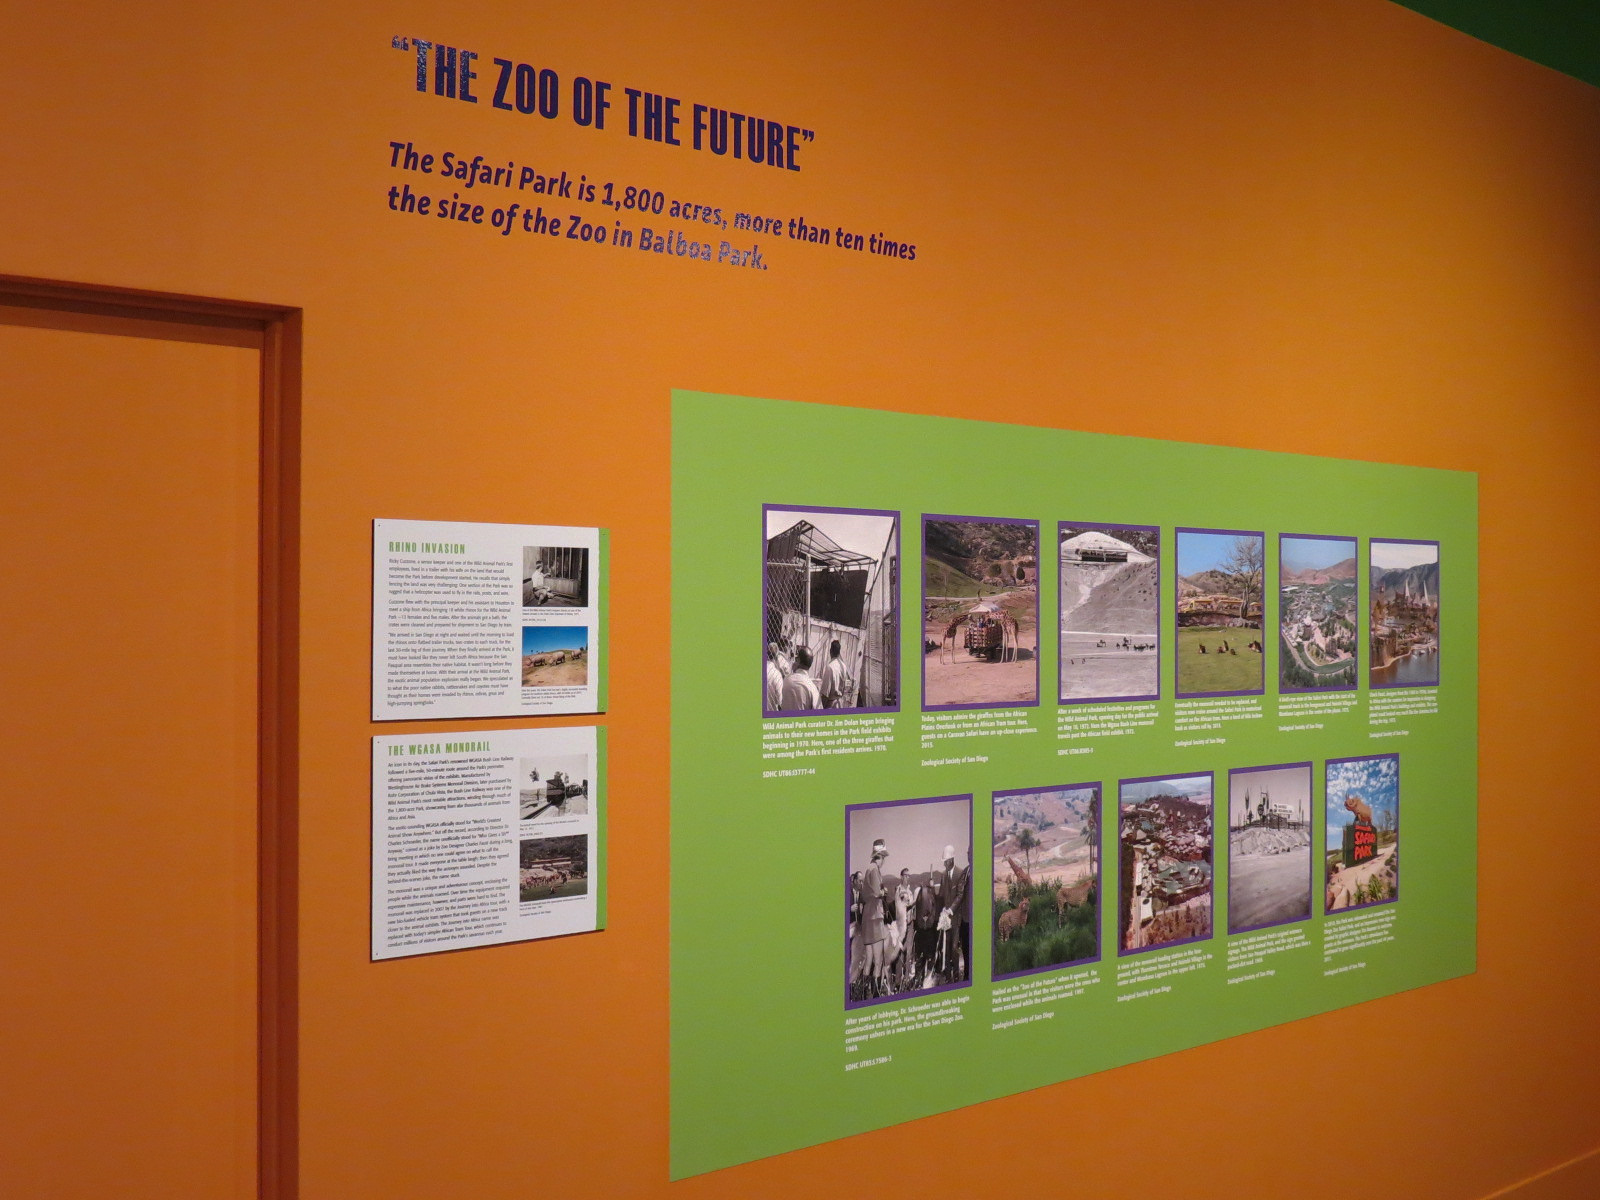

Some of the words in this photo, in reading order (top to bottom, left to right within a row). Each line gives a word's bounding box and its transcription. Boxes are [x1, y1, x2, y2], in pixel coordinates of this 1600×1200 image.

[493, 57, 559, 120] ZOO
[572, 75, 612, 130] OF
[625, 87, 681, 147] THE
[389, 141, 434, 174] The
[441, 150, 513, 188] Safari
[519, 165, 573, 200] Park
[577, 174, 596, 203] is
[601, 181, 665, 215] 1,800
[669, 197, 728, 231] acres,
[733, 206, 783, 237] more
[787, 217, 831, 246] than
[834, 225, 865, 253] ten
[869, 231, 917, 261] times
[387, 186, 431, 215] the
[437, 193, 484, 225] size
[491, 203, 520, 237] of
[522, 207, 561, 236] the
[566, 215, 607, 245] Zoo
[612, 220, 634, 250] in
[638, 227, 713, 263] Balboa
[717, 240, 769, 271] Park.
[389, 541, 417, 553] RHINO
[421, 542, 465, 554] INVASION
[388, 745, 404, 756] THE
[409, 744, 441, 755] WGASA
[445, 741, 491, 753] MONORAIL
[763, 741, 788, 750] beginning
[776, 751, 794, 759] among
[763, 770, 776, 778] SDHC
